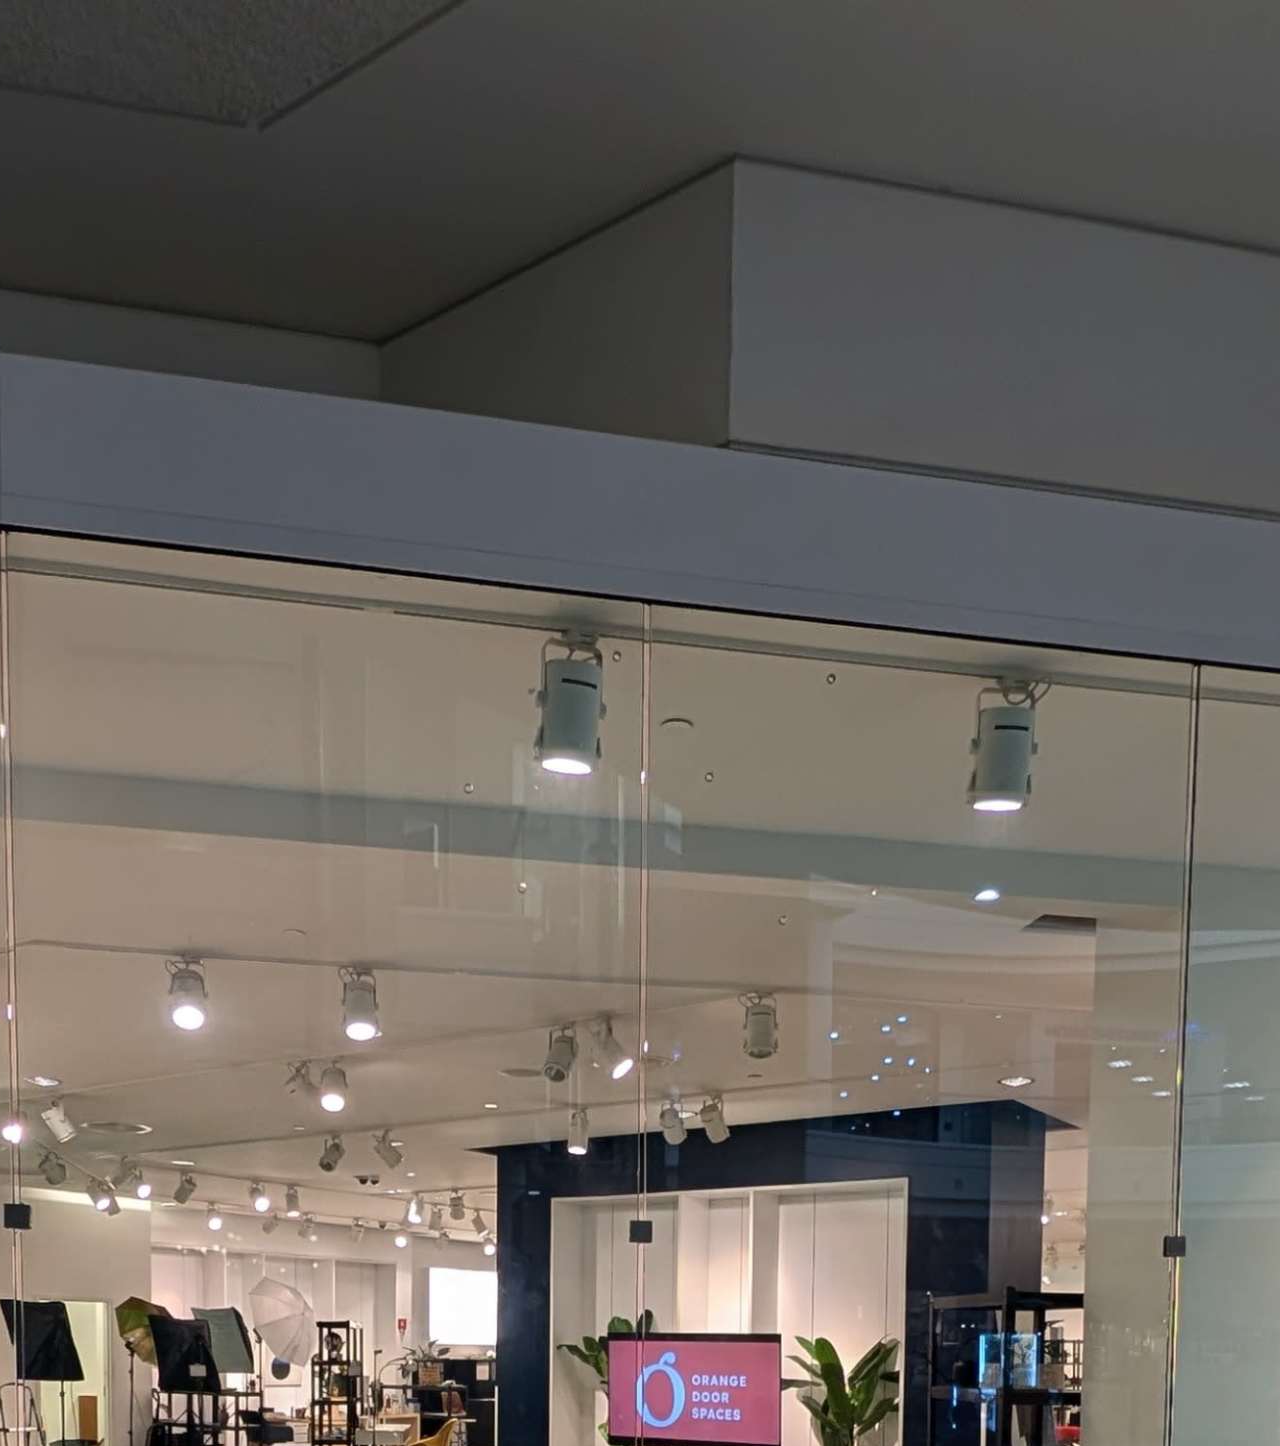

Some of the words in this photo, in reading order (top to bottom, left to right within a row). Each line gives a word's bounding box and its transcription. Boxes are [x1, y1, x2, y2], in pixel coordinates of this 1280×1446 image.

[691, 1374, 748, 1387] ORANGE
[691, 1391, 730, 1403] DOOR
[691, 1408, 742, 1421] SPACES
